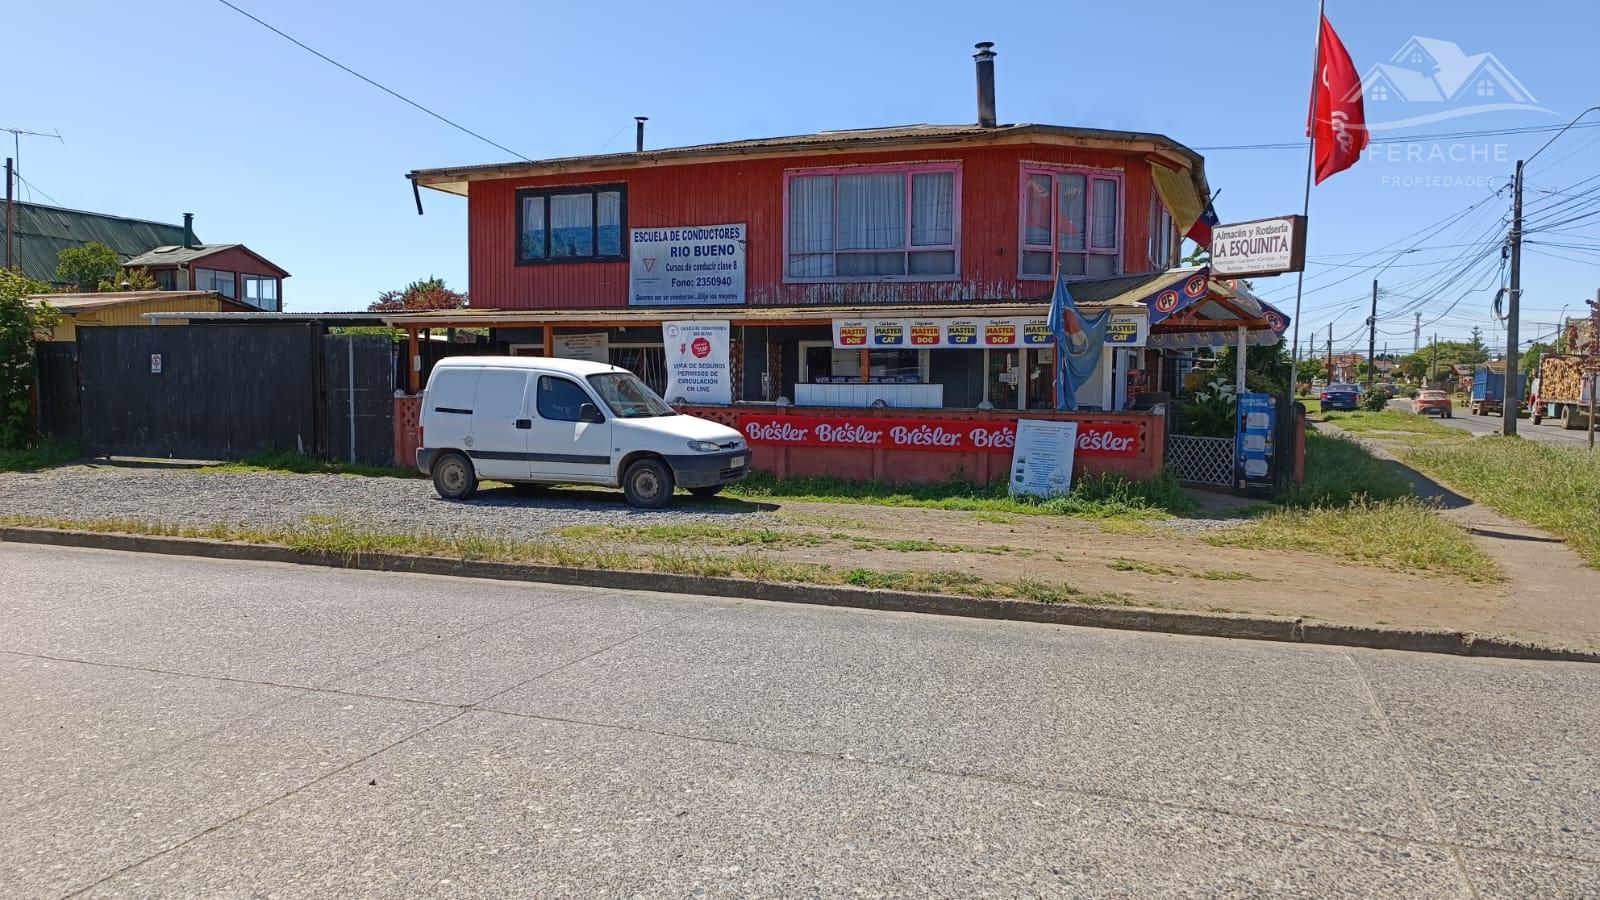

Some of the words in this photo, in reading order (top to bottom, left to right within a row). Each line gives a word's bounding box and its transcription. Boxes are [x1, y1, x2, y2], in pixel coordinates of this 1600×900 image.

[634, 232, 668, 242] ESCUELA
[670, 230, 680, 241] DE
[682, 228, 740, 240] CONDUCTORES
[1216, 228, 1246, 240] Almacén
[1248, 230, 1254, 238] y
[670, 246, 690, 257] RIO
[694, 244, 735, 257] BUENO
[1214, 242, 1226, 258] LA
[1230, 236, 1288, 257] ESQUINITA
[666, 263, 684, 272] Cursos
[685, 262, 692, 271] de
[693, 262, 717, 271] conducir
[718, 261, 731, 270] clase
[733, 261, 737, 270] B
[671, 278, 694, 287] Fono:
[696, 276, 732, 286] 2350940
